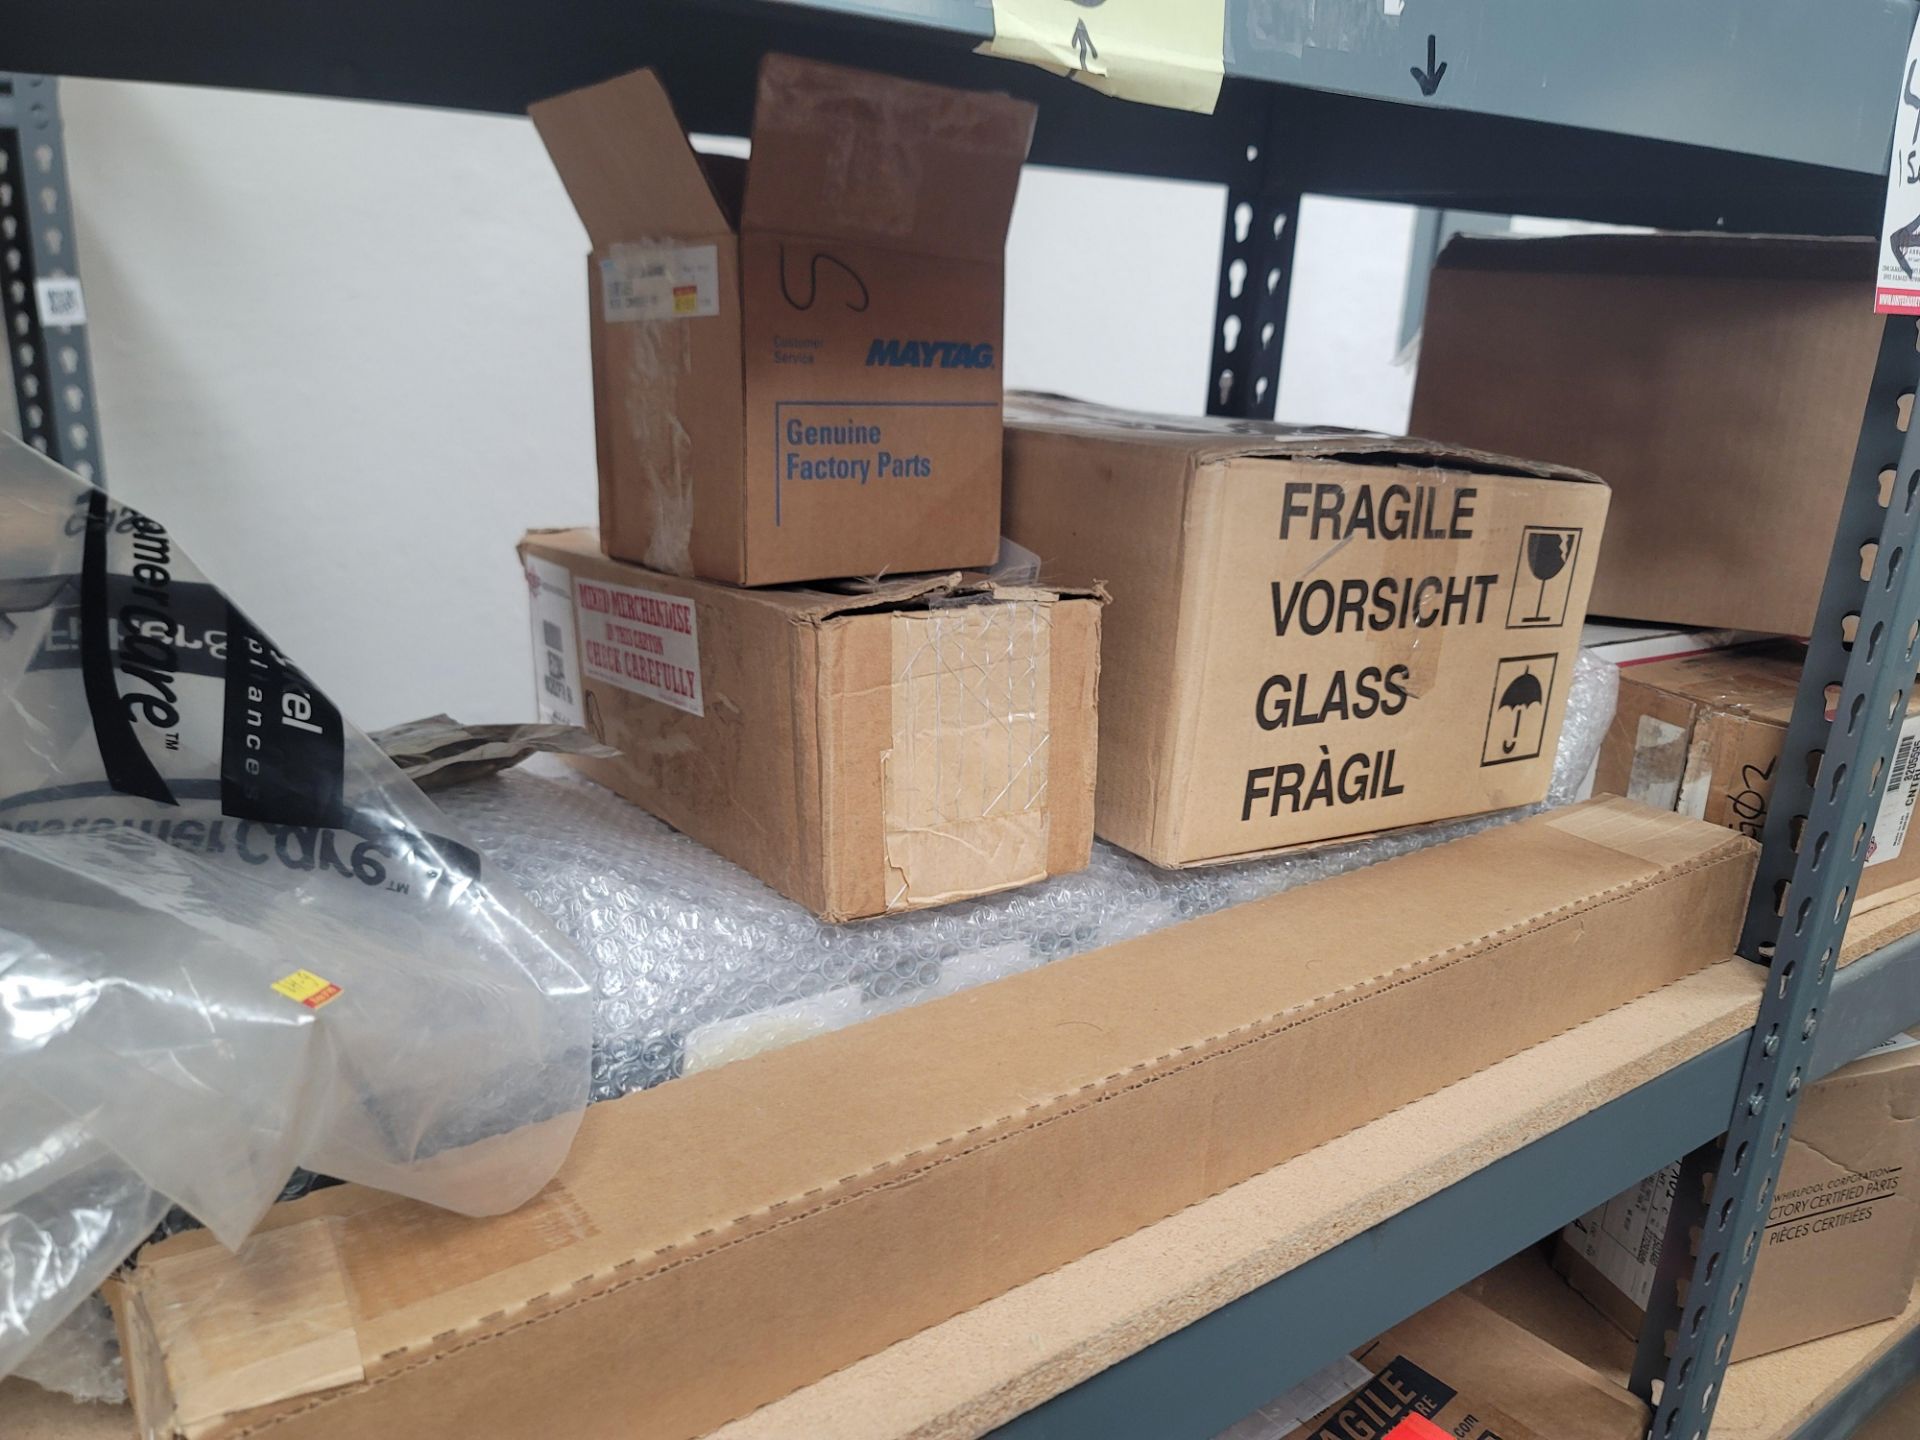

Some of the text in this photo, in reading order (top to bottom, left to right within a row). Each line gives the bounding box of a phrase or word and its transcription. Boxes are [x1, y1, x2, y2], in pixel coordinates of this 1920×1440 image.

[864, 338, 996, 369] MAYTAG
[786, 418, 881, 446] Genuine
[786, 451, 932, 485] Factory Parts
[1278, 481, 1478, 541] FRAGILE
[610, 589, 692, 635] MERCHANDISE
[1270, 574, 1499, 637] VORSICHT
[586, 639, 696, 700] CHECK CAREFULLY
[1254, 664, 1411, 731] GLASS
[1240, 744, 1405, 822] FRÀGIL
[1768, 1176, 1900, 1221] CTORY CERTIFIED PARTS
[1773, 1167, 1890, 1203] WHIRLPOOL CORPORATION
[1769, 1206, 1873, 1246] PIÈCES CERTIFIÉES
